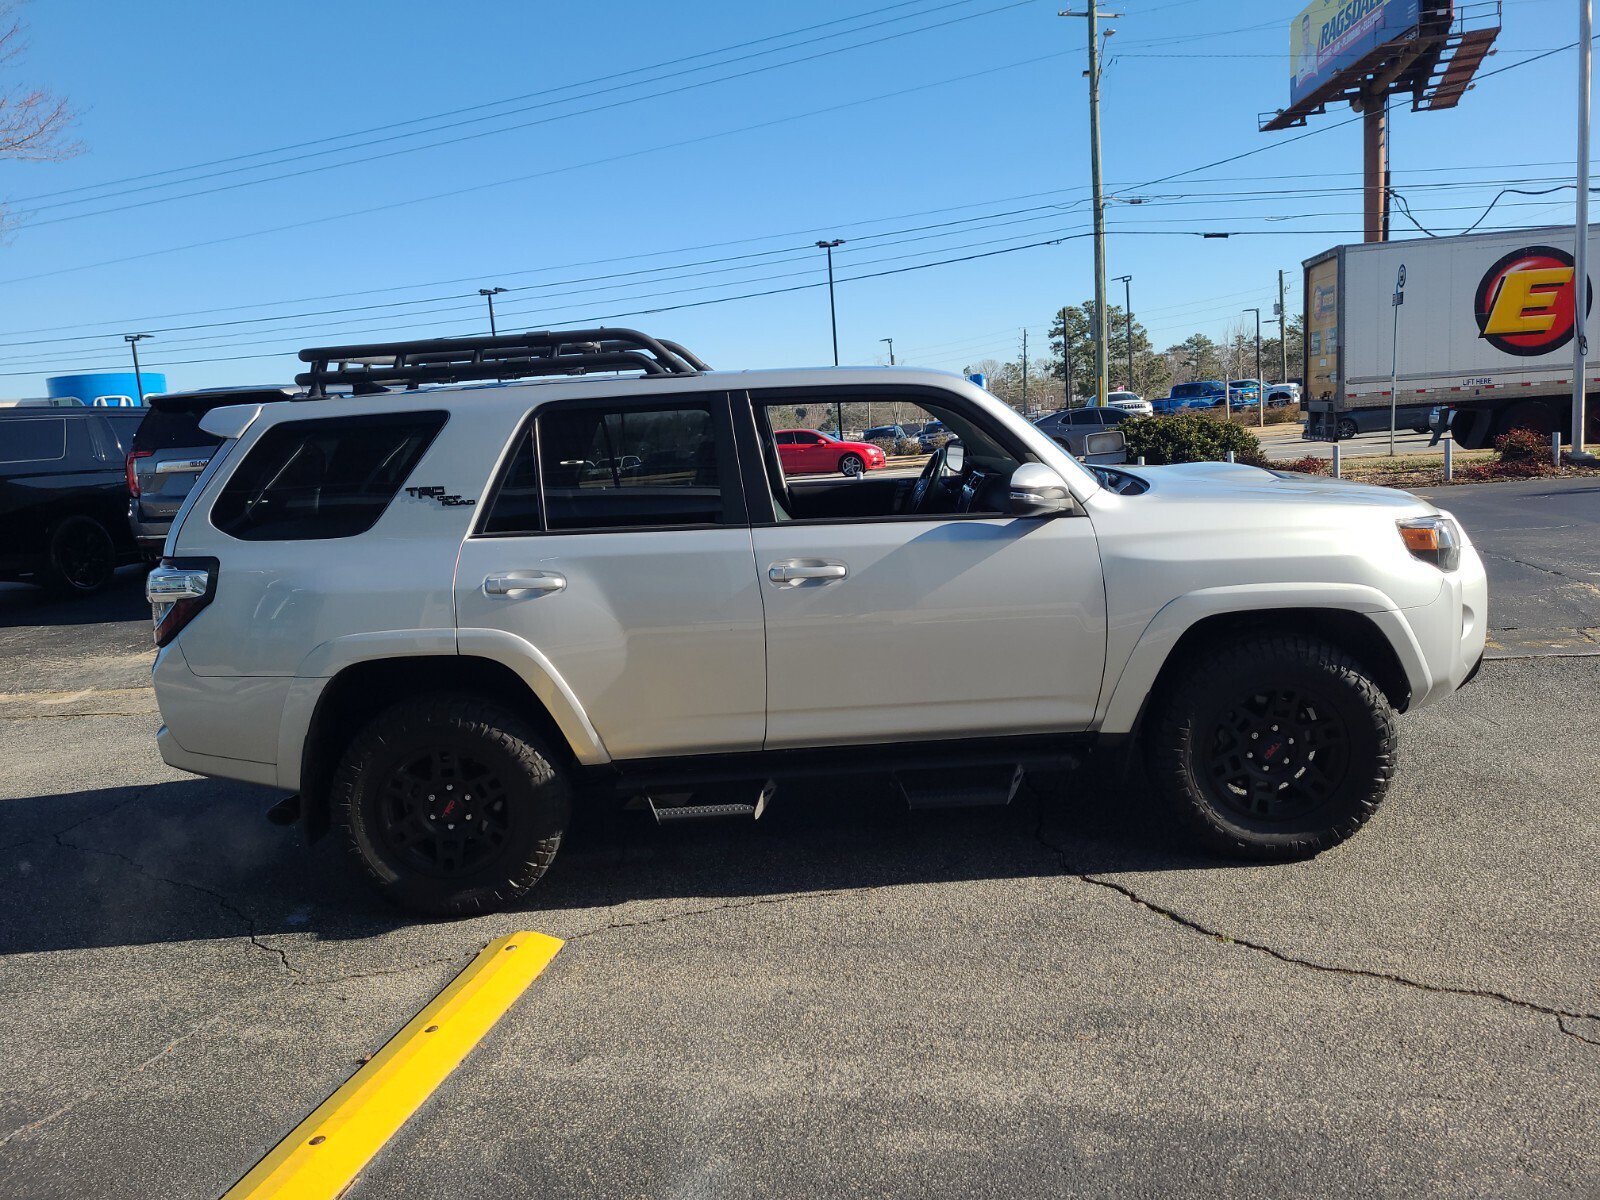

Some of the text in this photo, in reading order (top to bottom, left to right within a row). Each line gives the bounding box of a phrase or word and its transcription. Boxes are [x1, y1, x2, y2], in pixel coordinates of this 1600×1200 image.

[1320, 0, 1384, 50] RAGSDA
[1480, 266, 1575, 338] E
[1476, 377, 1492, 385] HERE
[405, 486, 446, 499] TRD
